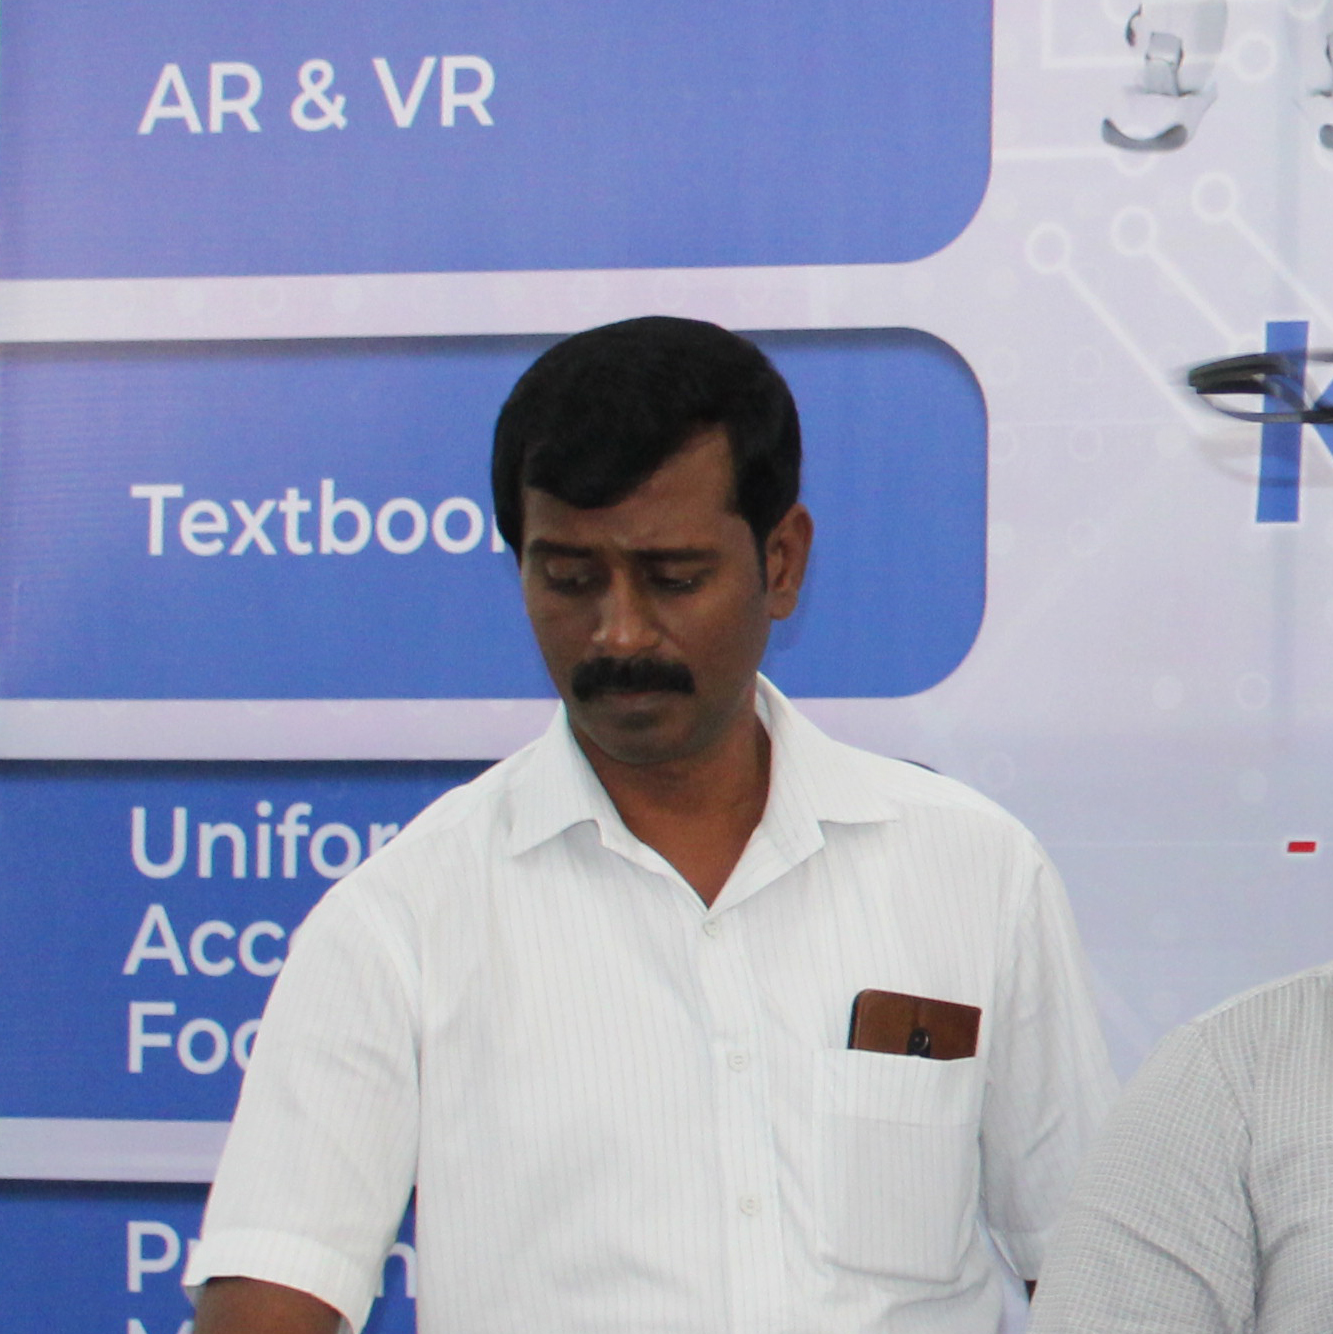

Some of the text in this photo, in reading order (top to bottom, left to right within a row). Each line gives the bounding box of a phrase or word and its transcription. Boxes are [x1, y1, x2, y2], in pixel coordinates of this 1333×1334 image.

[137, 54, 495, 135] AR & VR
[121, 902, 303, 978] Acc
